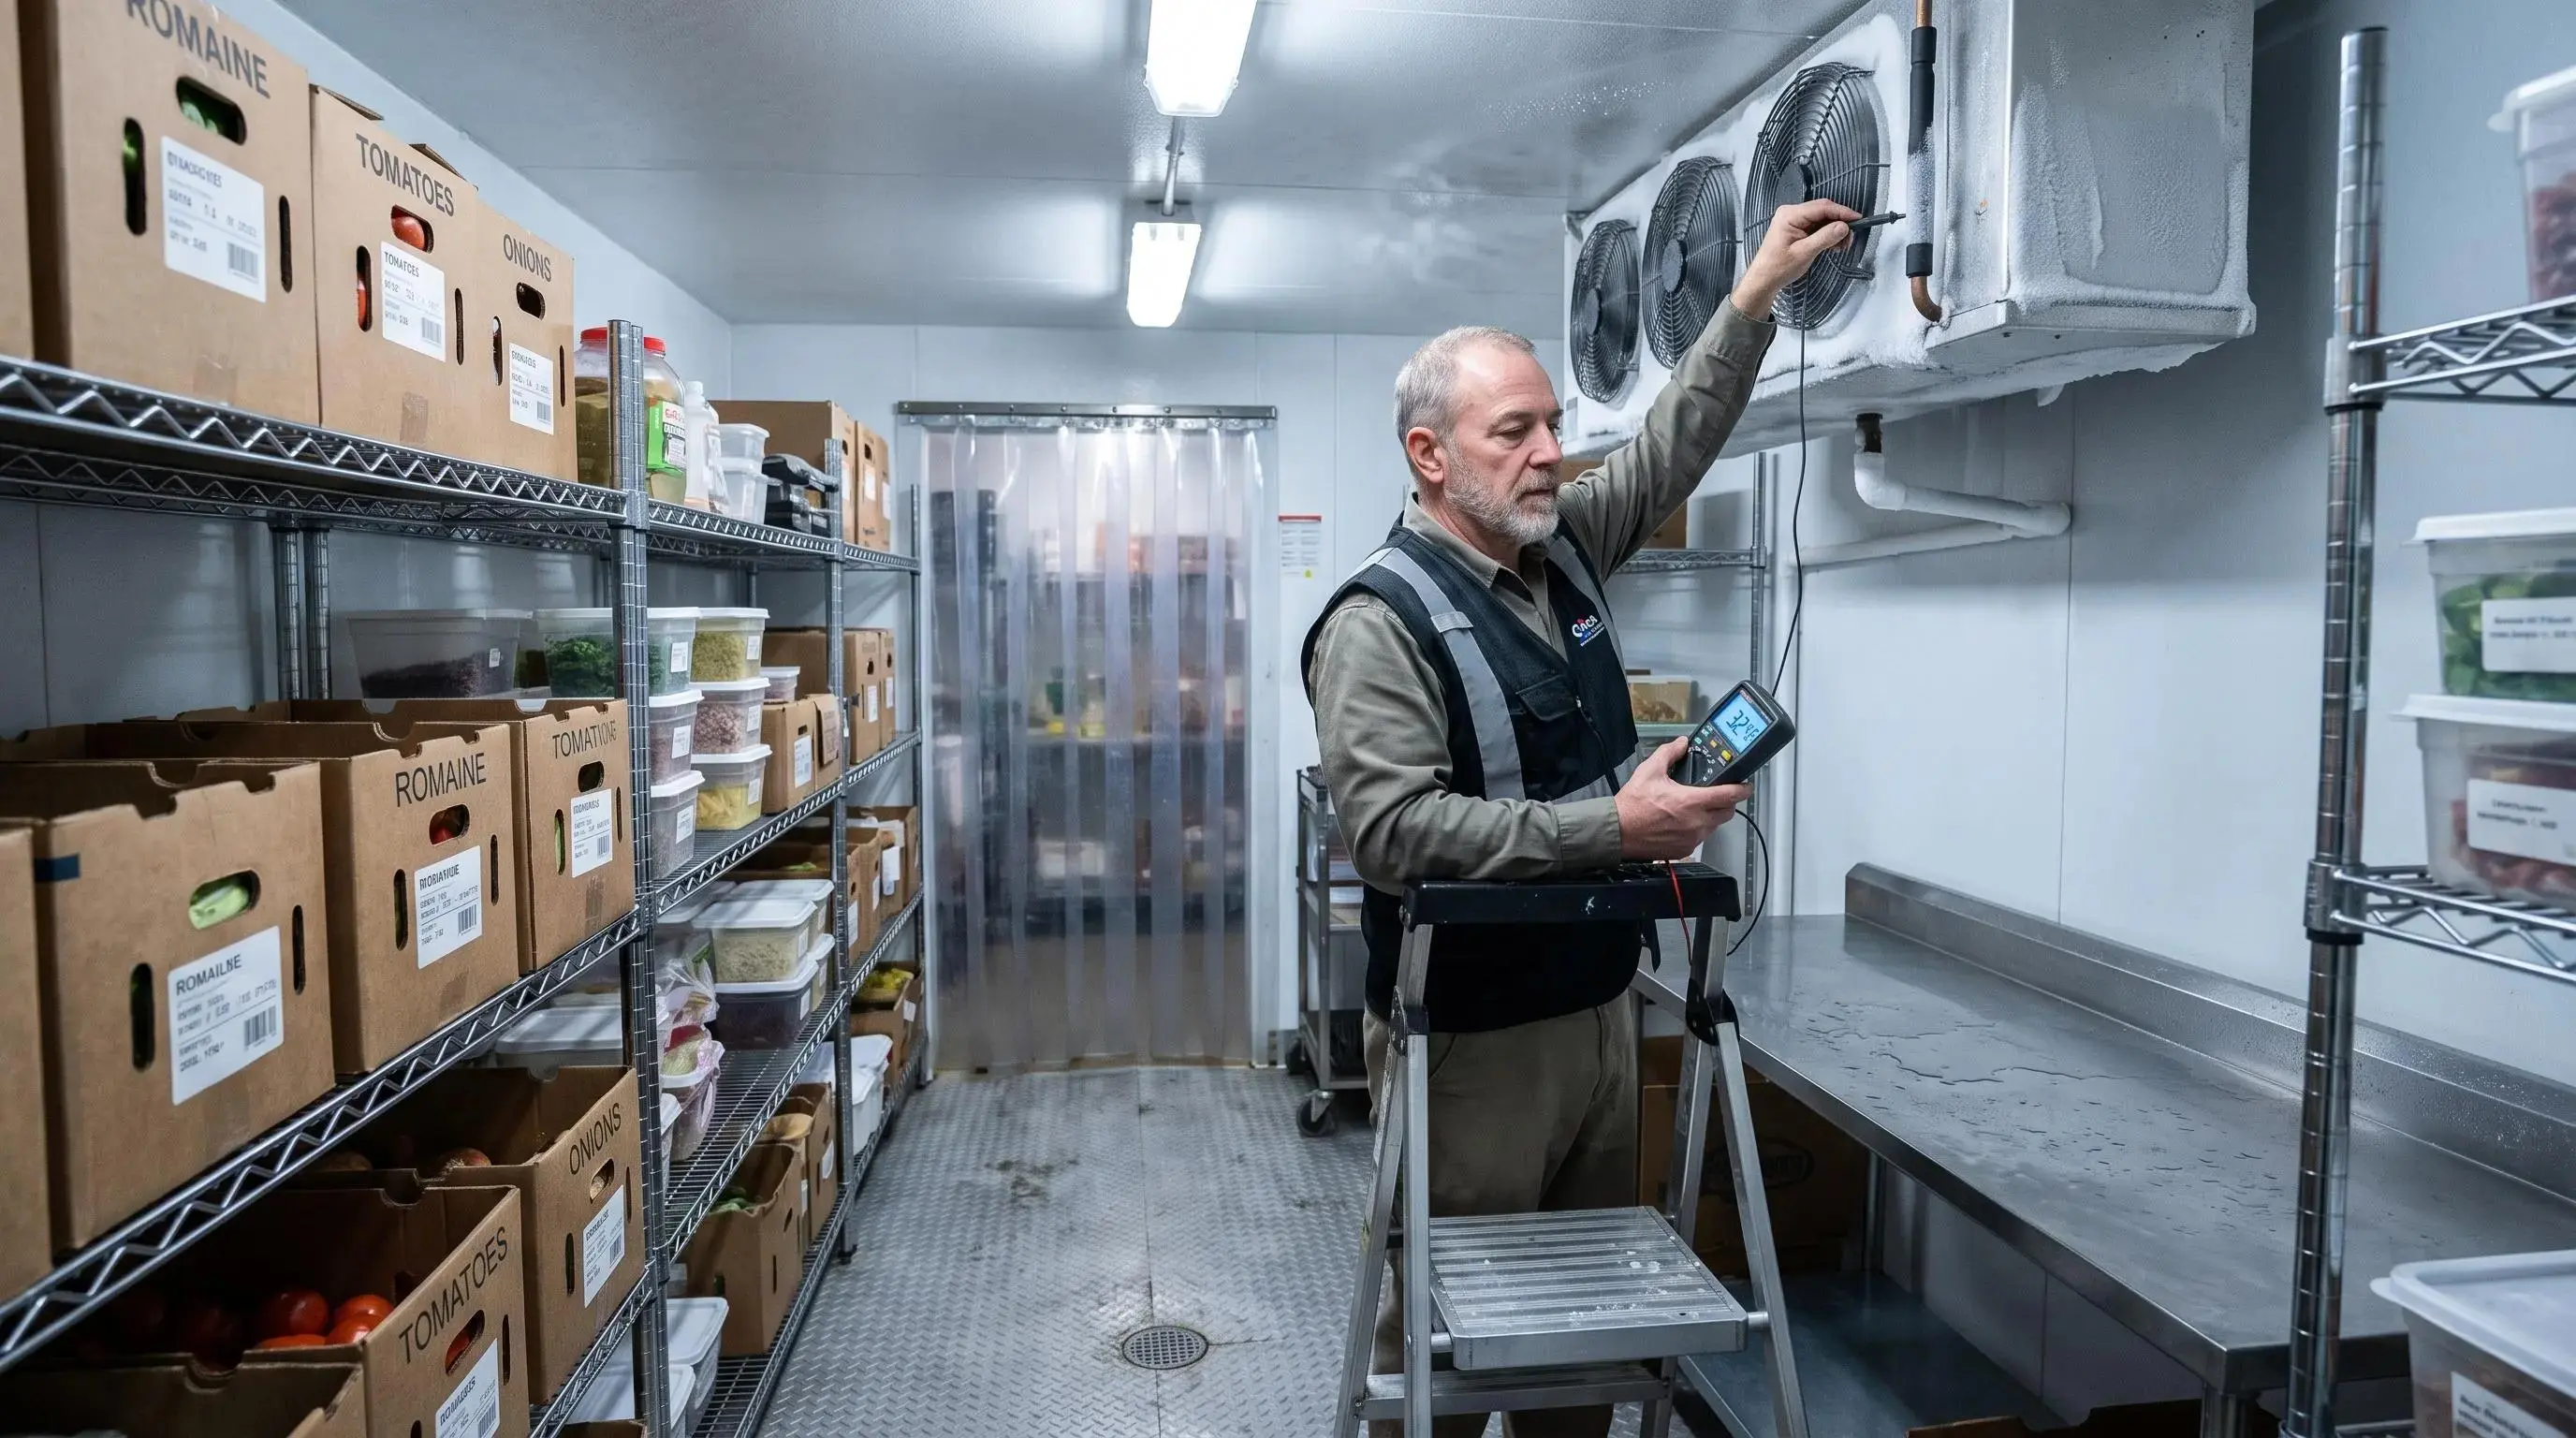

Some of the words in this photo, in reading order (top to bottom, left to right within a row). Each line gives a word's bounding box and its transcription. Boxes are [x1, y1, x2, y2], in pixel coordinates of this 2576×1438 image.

[356, 133, 454, 217] TOMATOES
[503, 233, 551, 283] ONIONS
[395, 752, 487, 808] ROMAINE
[569, 1102, 622, 1175] ONIONS
[398, 1225, 508, 1364] TOMATOES
